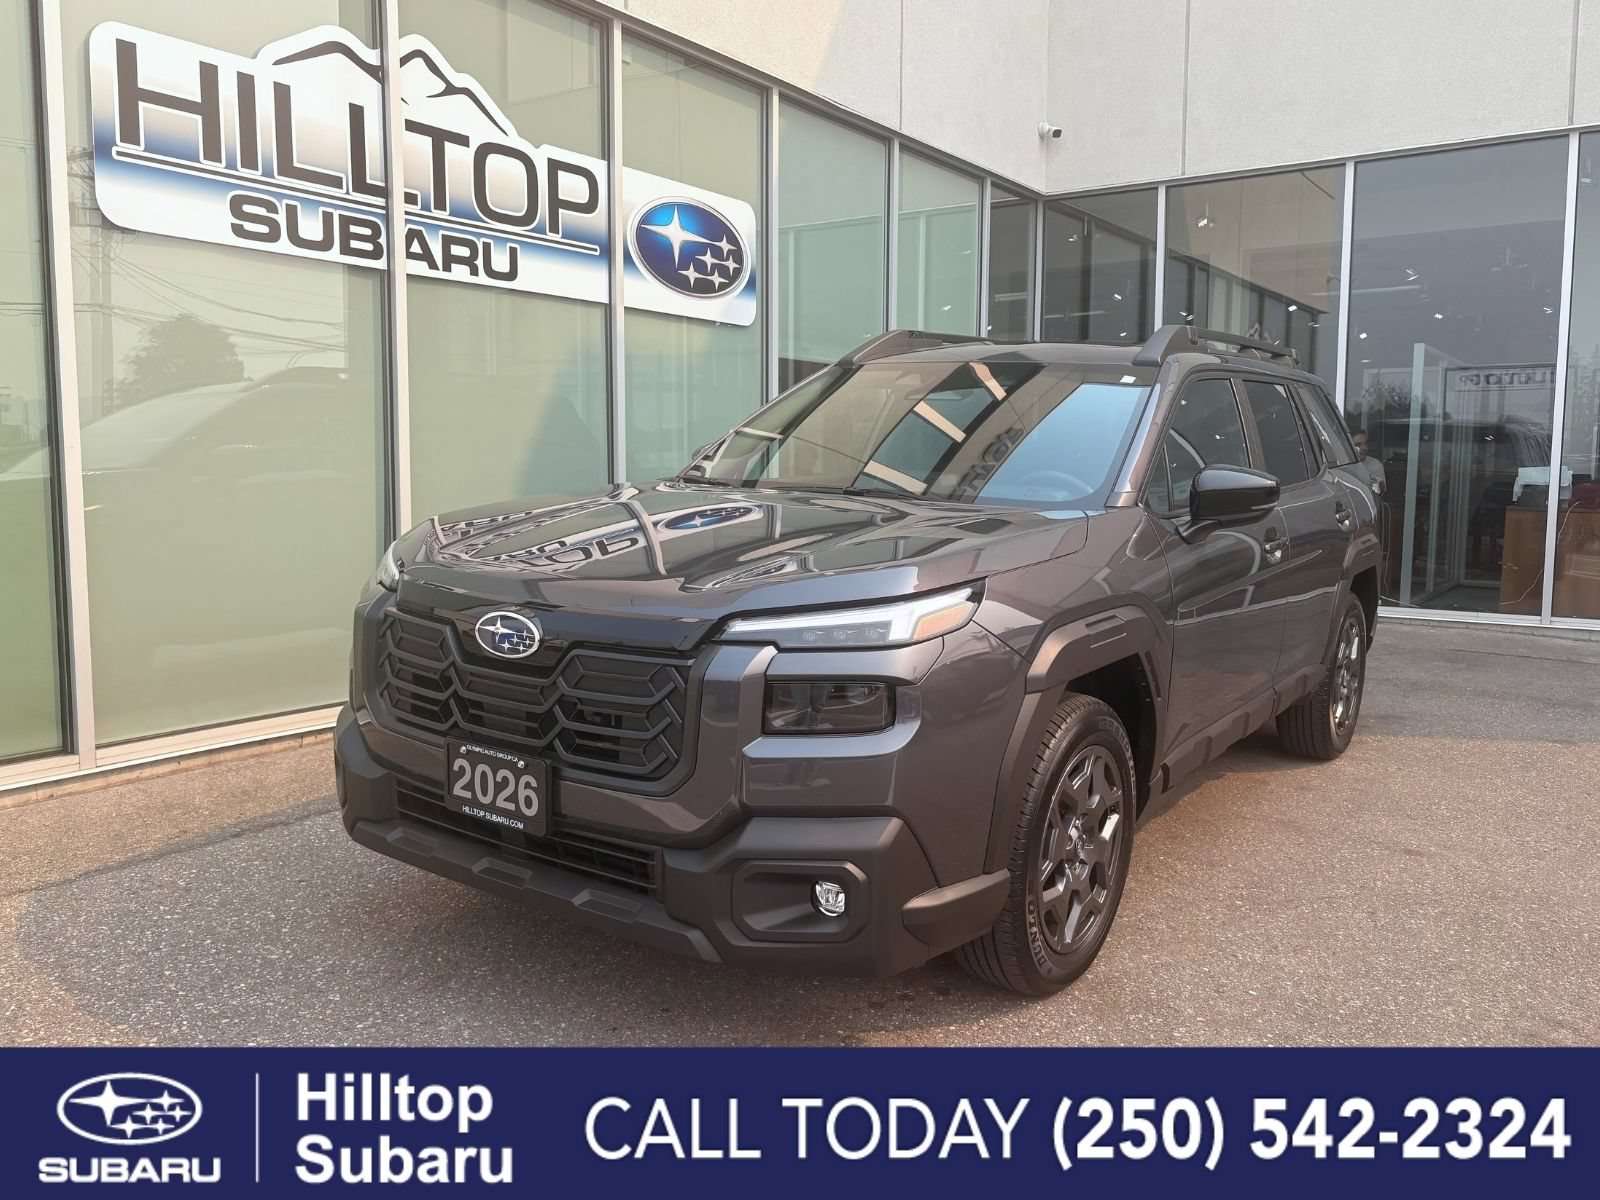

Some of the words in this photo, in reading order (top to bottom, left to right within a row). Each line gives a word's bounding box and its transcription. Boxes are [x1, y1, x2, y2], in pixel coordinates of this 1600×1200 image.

[115, 38, 600, 235] HILLTOP
[230, 195, 519, 282] SUBARU
[453, 758, 539, 816] 2026
[462, 804, 485, 817] HILLTOP
